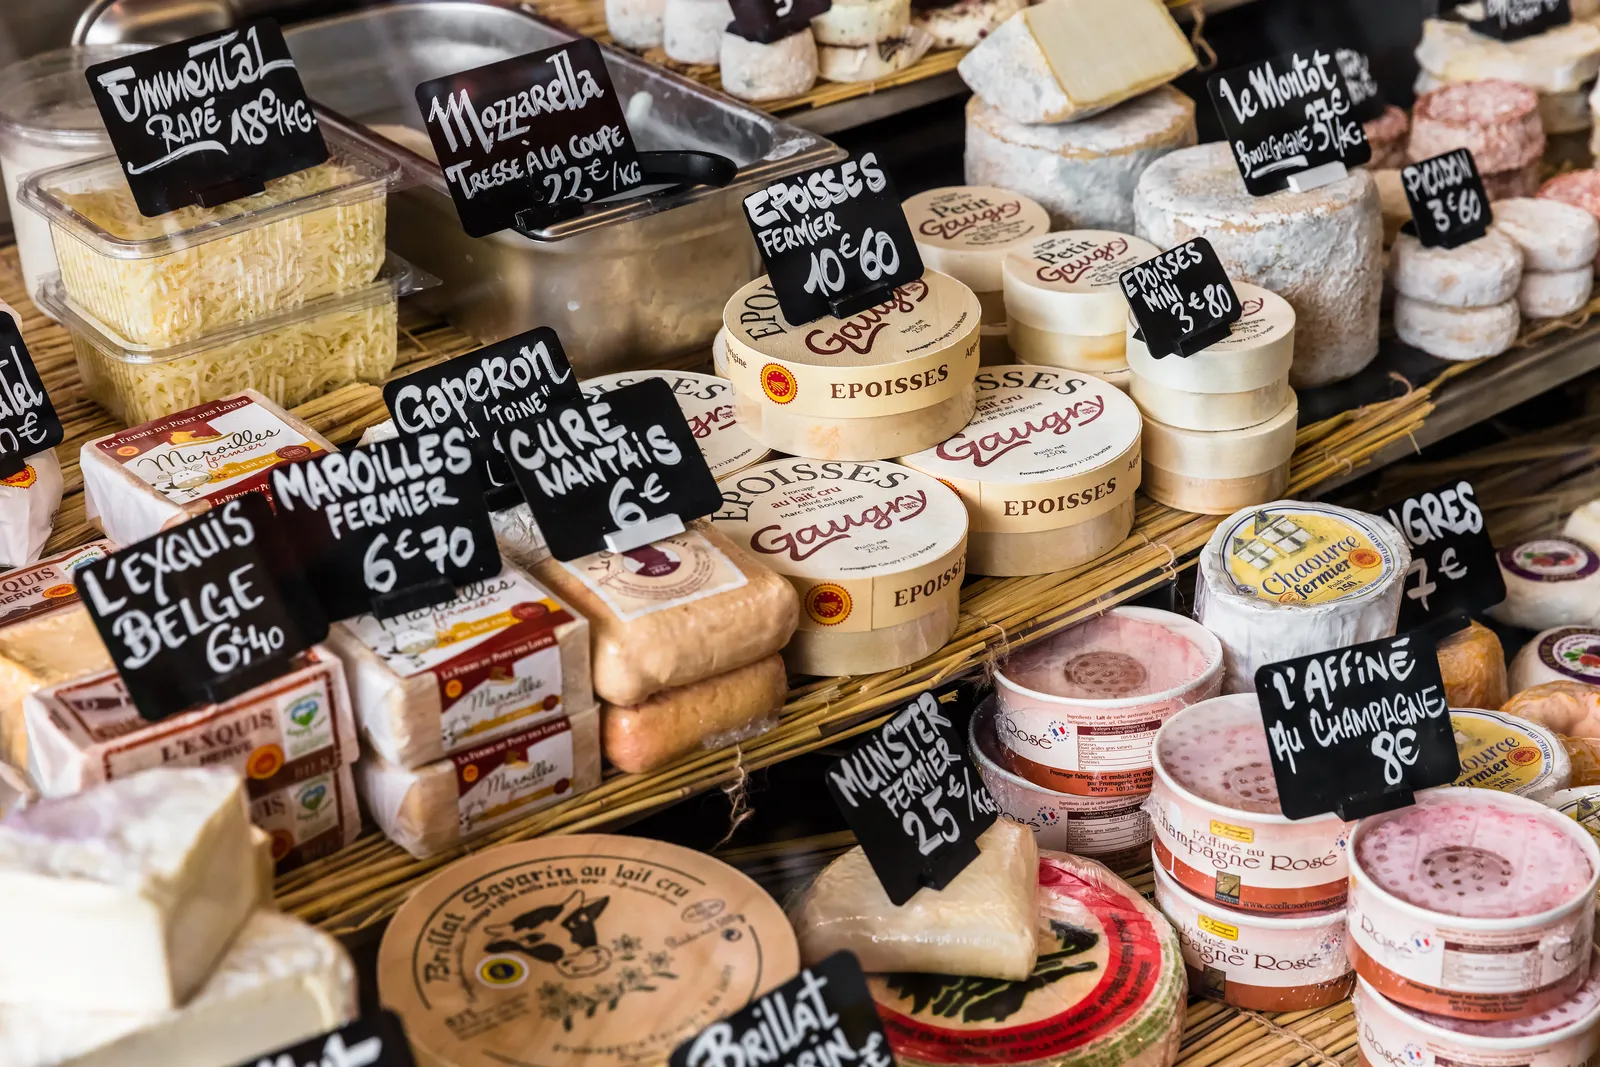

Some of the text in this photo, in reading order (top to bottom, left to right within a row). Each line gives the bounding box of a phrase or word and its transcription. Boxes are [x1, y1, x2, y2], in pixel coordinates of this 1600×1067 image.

[97, 26, 296, 122] Emmental
[428, 50, 604, 153] Mozzarella
[1249, 49, 1337, 111] Montot
[146, 97, 222, 153] RAPÉ
[445, 159, 528, 199] TRESSE
[568, 124, 625, 158] COUPE
[744, 152, 886, 226] EPOISSES
[1402, 150, 1473, 201] PICODON
[757, 211, 842, 258] FERMIER
[1122, 242, 1202, 298] EPOISSES
[1142, 280, 1183, 312] MINI
[394, 341, 571, 433] Gaperon
[831, 364, 949, 399] EPOISSES
[1000, 394, 1023, 405] cru
[117, 427, 153, 446] FERME
[154, 423, 168, 434] DU
[168, 415, 197, 429] PONT
[197, 409, 217, 421] DES
[217, 399, 250, 415] LOUPS
[138, 429, 281, 472] Maroilles
[509, 394, 627, 470] CURÉ
[936, 395, 1104, 467] Gaugry
[205, 441, 268, 470] fermier
[273, 426, 472, 510] MAROILLES
[535, 425, 682, 497] NANTAIS
[325, 476, 459, 540] FERMIER
[711, 463, 908, 522] EPOISSES
[772, 486, 842, 509] au lait cru
[1004, 477, 1117, 516] EPOISSES
[750, 489, 927, 562] Gaugry
[83, 501, 254, 616] L'EXQUIS
[893, 551, 967, 607] EPOISSE
[1262, 534, 1362, 596] Chaource
[1294, 558, 1352, 601] fermier
[112, 563, 264, 669] BELGE
[1269, 718, 1306, 775] AU
[1309, 684, 1446, 748] CHAMPAGNE
[830, 692, 951, 808] MUNSTER
[880, 737, 961, 818] FERMIER
[1270, 850, 1338, 872] Rosé
[424, 912, 466, 984] Brillat
[463, 864, 573, 910] Savarin
[580, 865, 607, 878] au
[615, 864, 652, 885] lait
[655, 876, 691, 898] cru
[1254, 953, 1322, 972] Rosé
